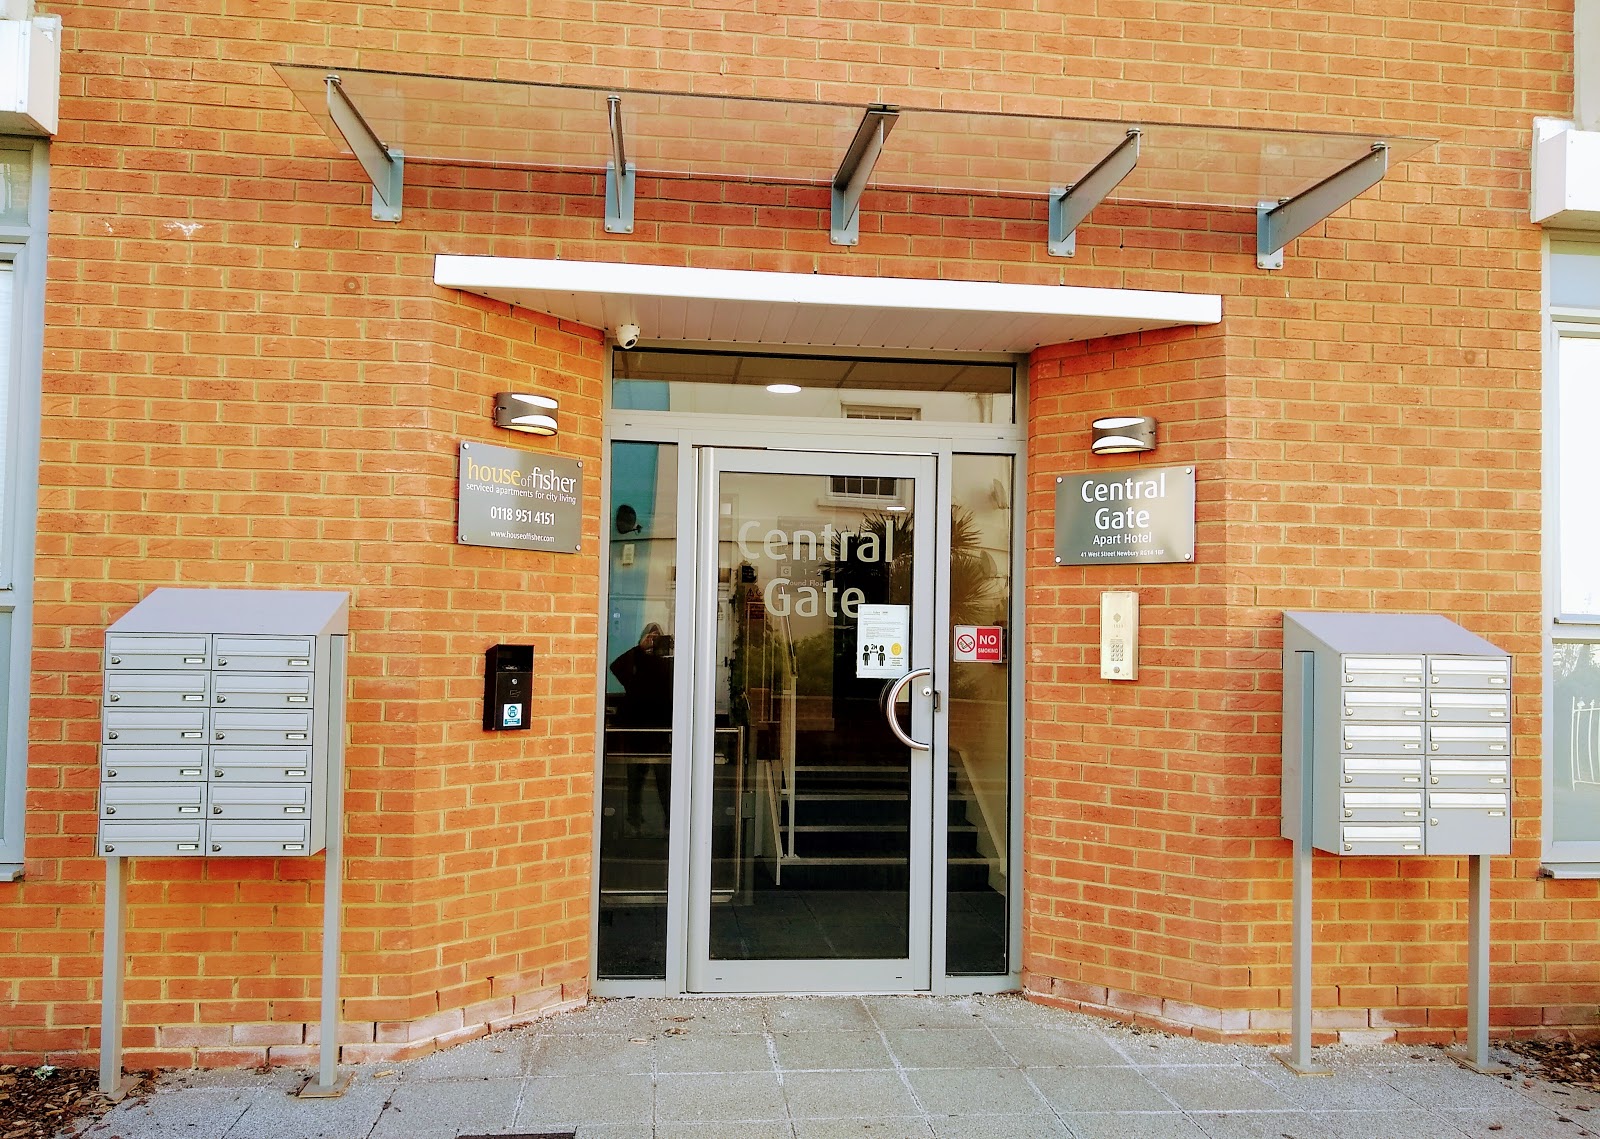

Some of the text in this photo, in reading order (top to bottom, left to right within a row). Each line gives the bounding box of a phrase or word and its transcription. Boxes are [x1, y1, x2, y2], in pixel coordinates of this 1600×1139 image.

[467, 457, 521, 486] house
[531, 467, 577, 493] fisher
[466, 483, 576, 505] serviced apartments for city living
[1081, 472, 1166, 503] Central
[490, 506, 555, 526] 0118 951 4151
[1094, 506, 1150, 530] Gate
[490, 530, 555, 543] www.houseoffisher.com
[737, 519, 894, 563] Central
[1093, 531, 1152, 548] Apart Hotel
[1100, 550, 1116, 558] Street
[1116, 550, 1138, 558] Newbury
[763, 577, 866, 619] Gate
[979, 635, 997, 645] NO
